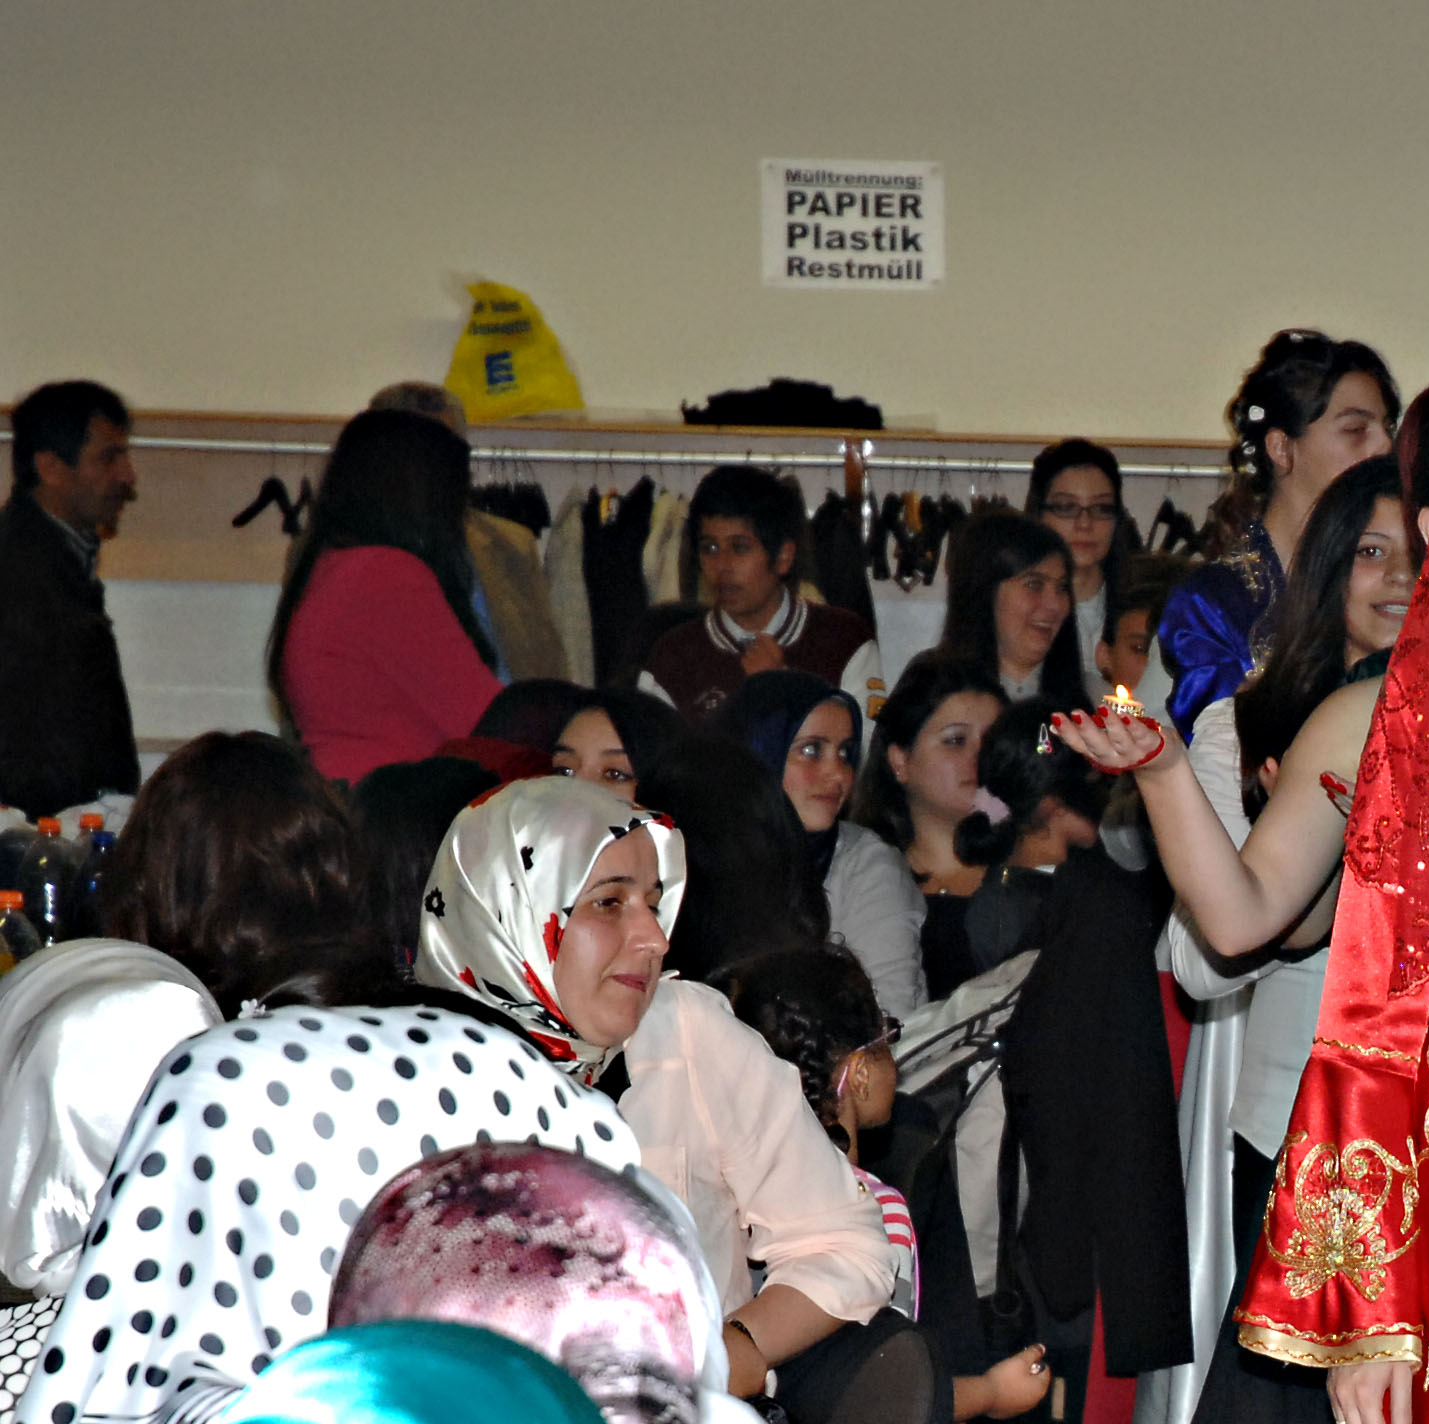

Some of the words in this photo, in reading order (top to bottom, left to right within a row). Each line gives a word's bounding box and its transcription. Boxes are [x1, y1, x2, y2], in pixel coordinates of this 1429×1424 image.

[785, 168, 923, 189] Mülltrennung:
[786, 190, 923, 218] PAPIER
[786, 222, 923, 251] Plastik
[786, 256, 923, 280] Restmüll
